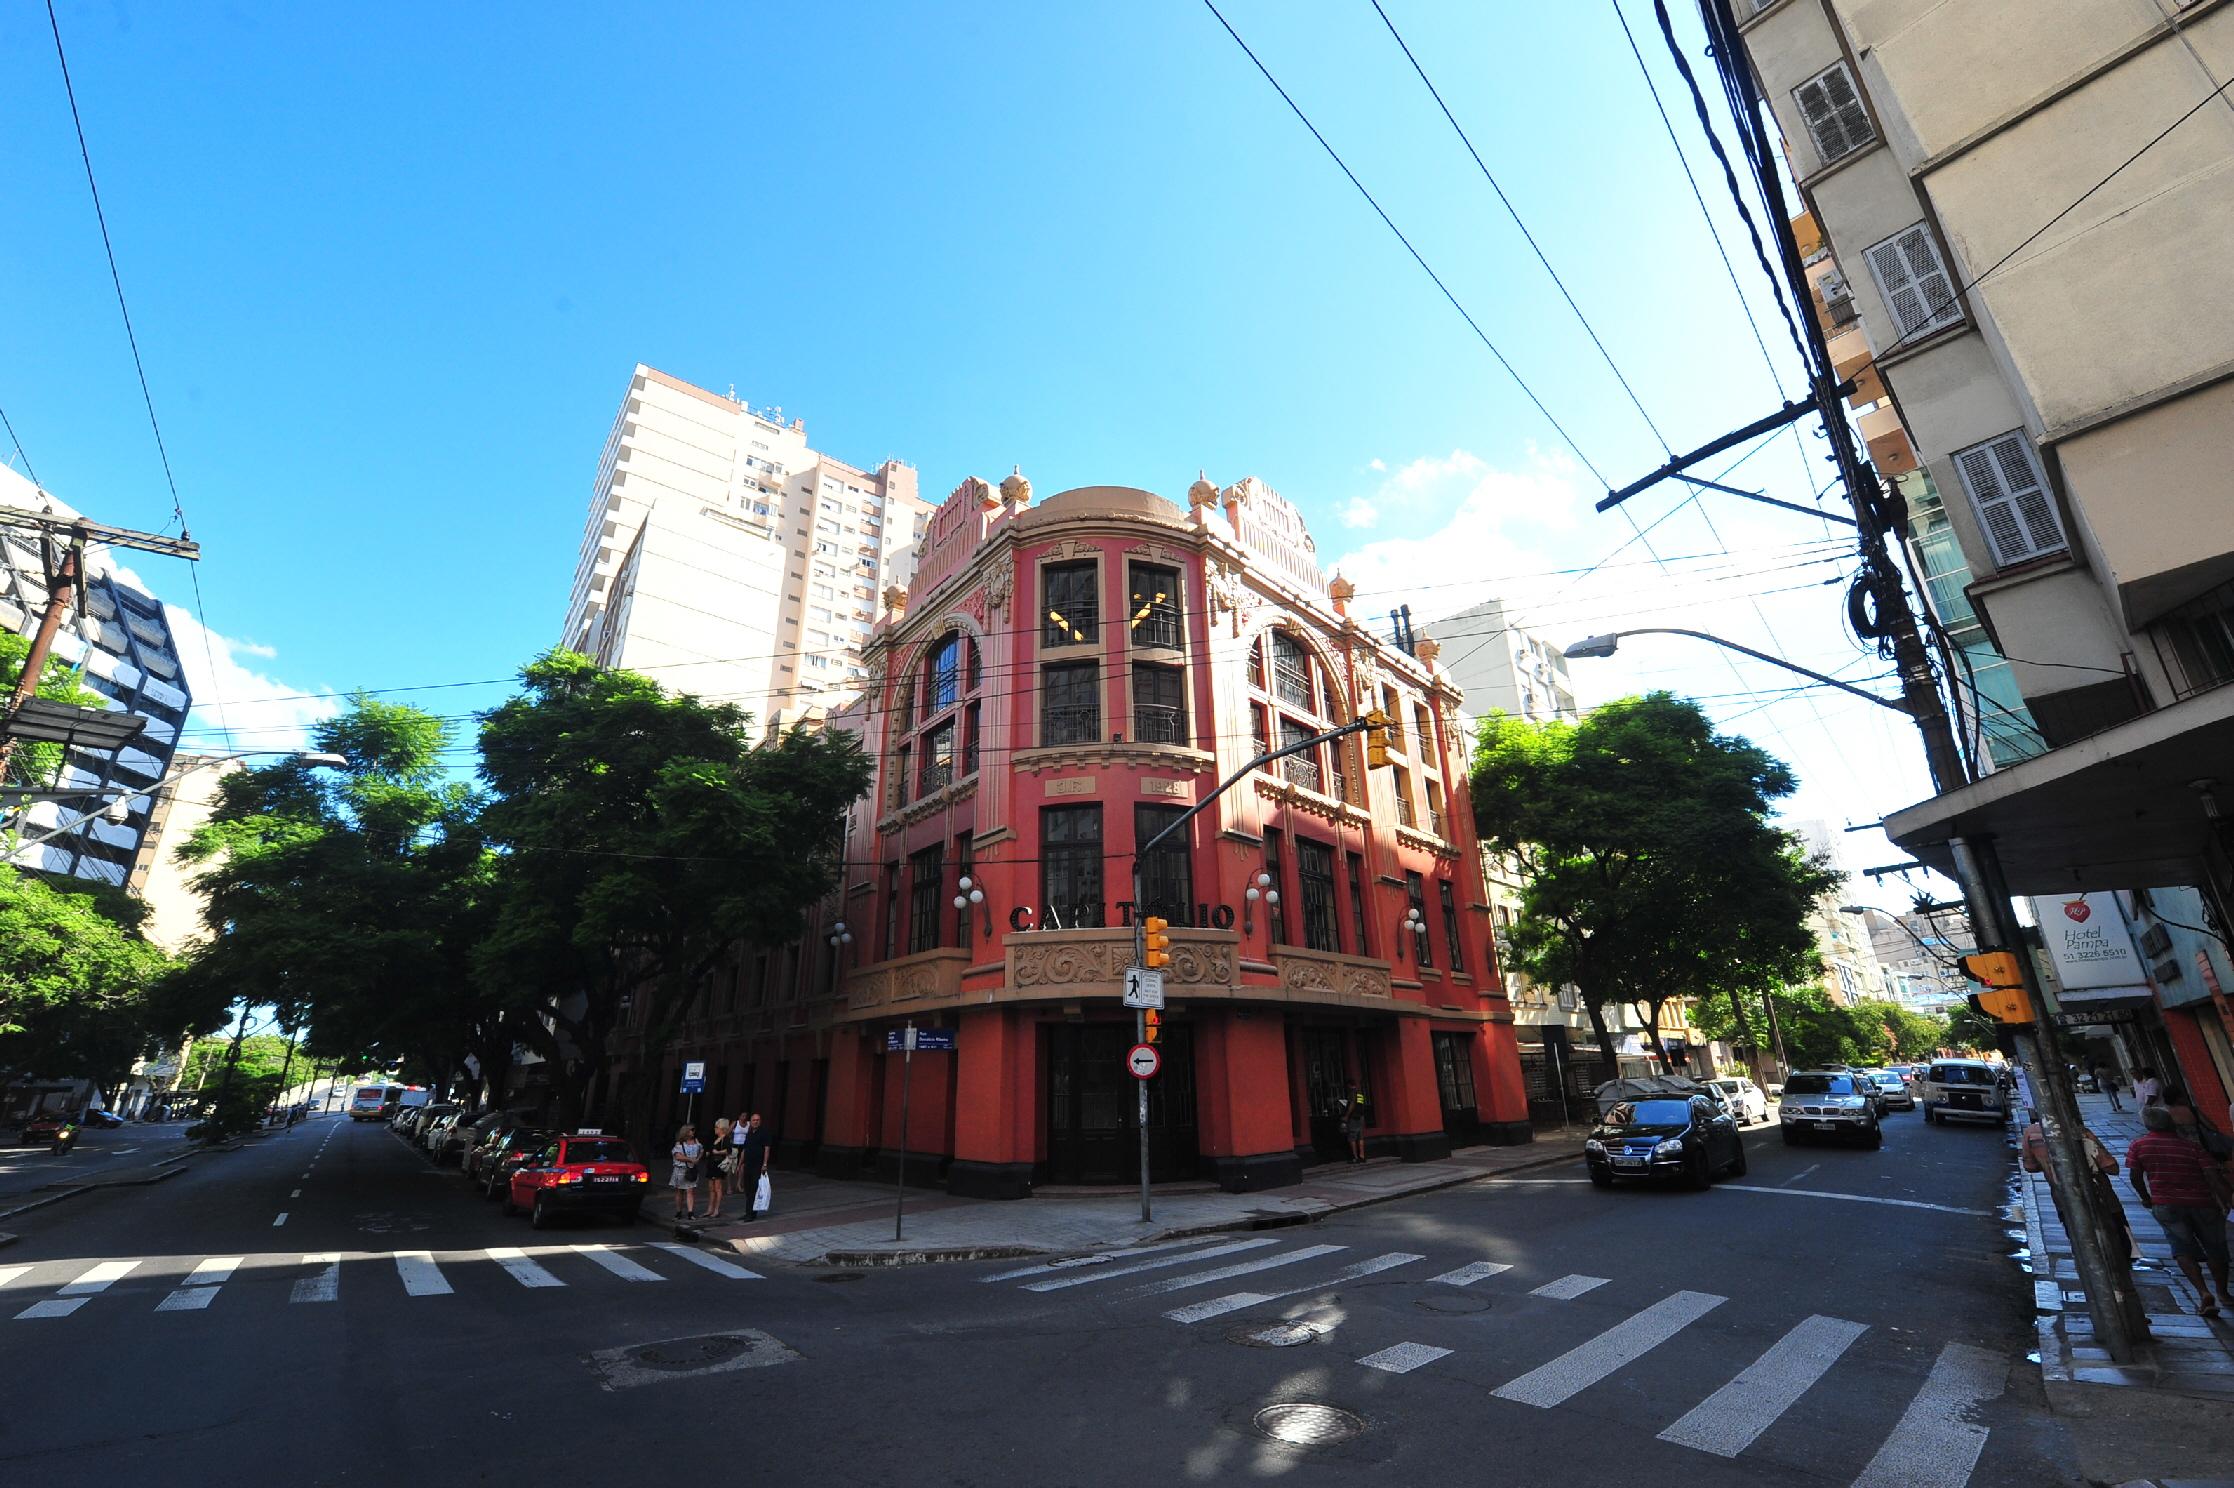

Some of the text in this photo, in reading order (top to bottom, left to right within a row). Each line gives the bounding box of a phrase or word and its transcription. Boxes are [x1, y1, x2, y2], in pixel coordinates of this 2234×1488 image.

[2064, 925, 2101, 941] Hotel
[2066, 939, 2109, 951] Pampa
[2077, 950, 2101, 959] 3226
